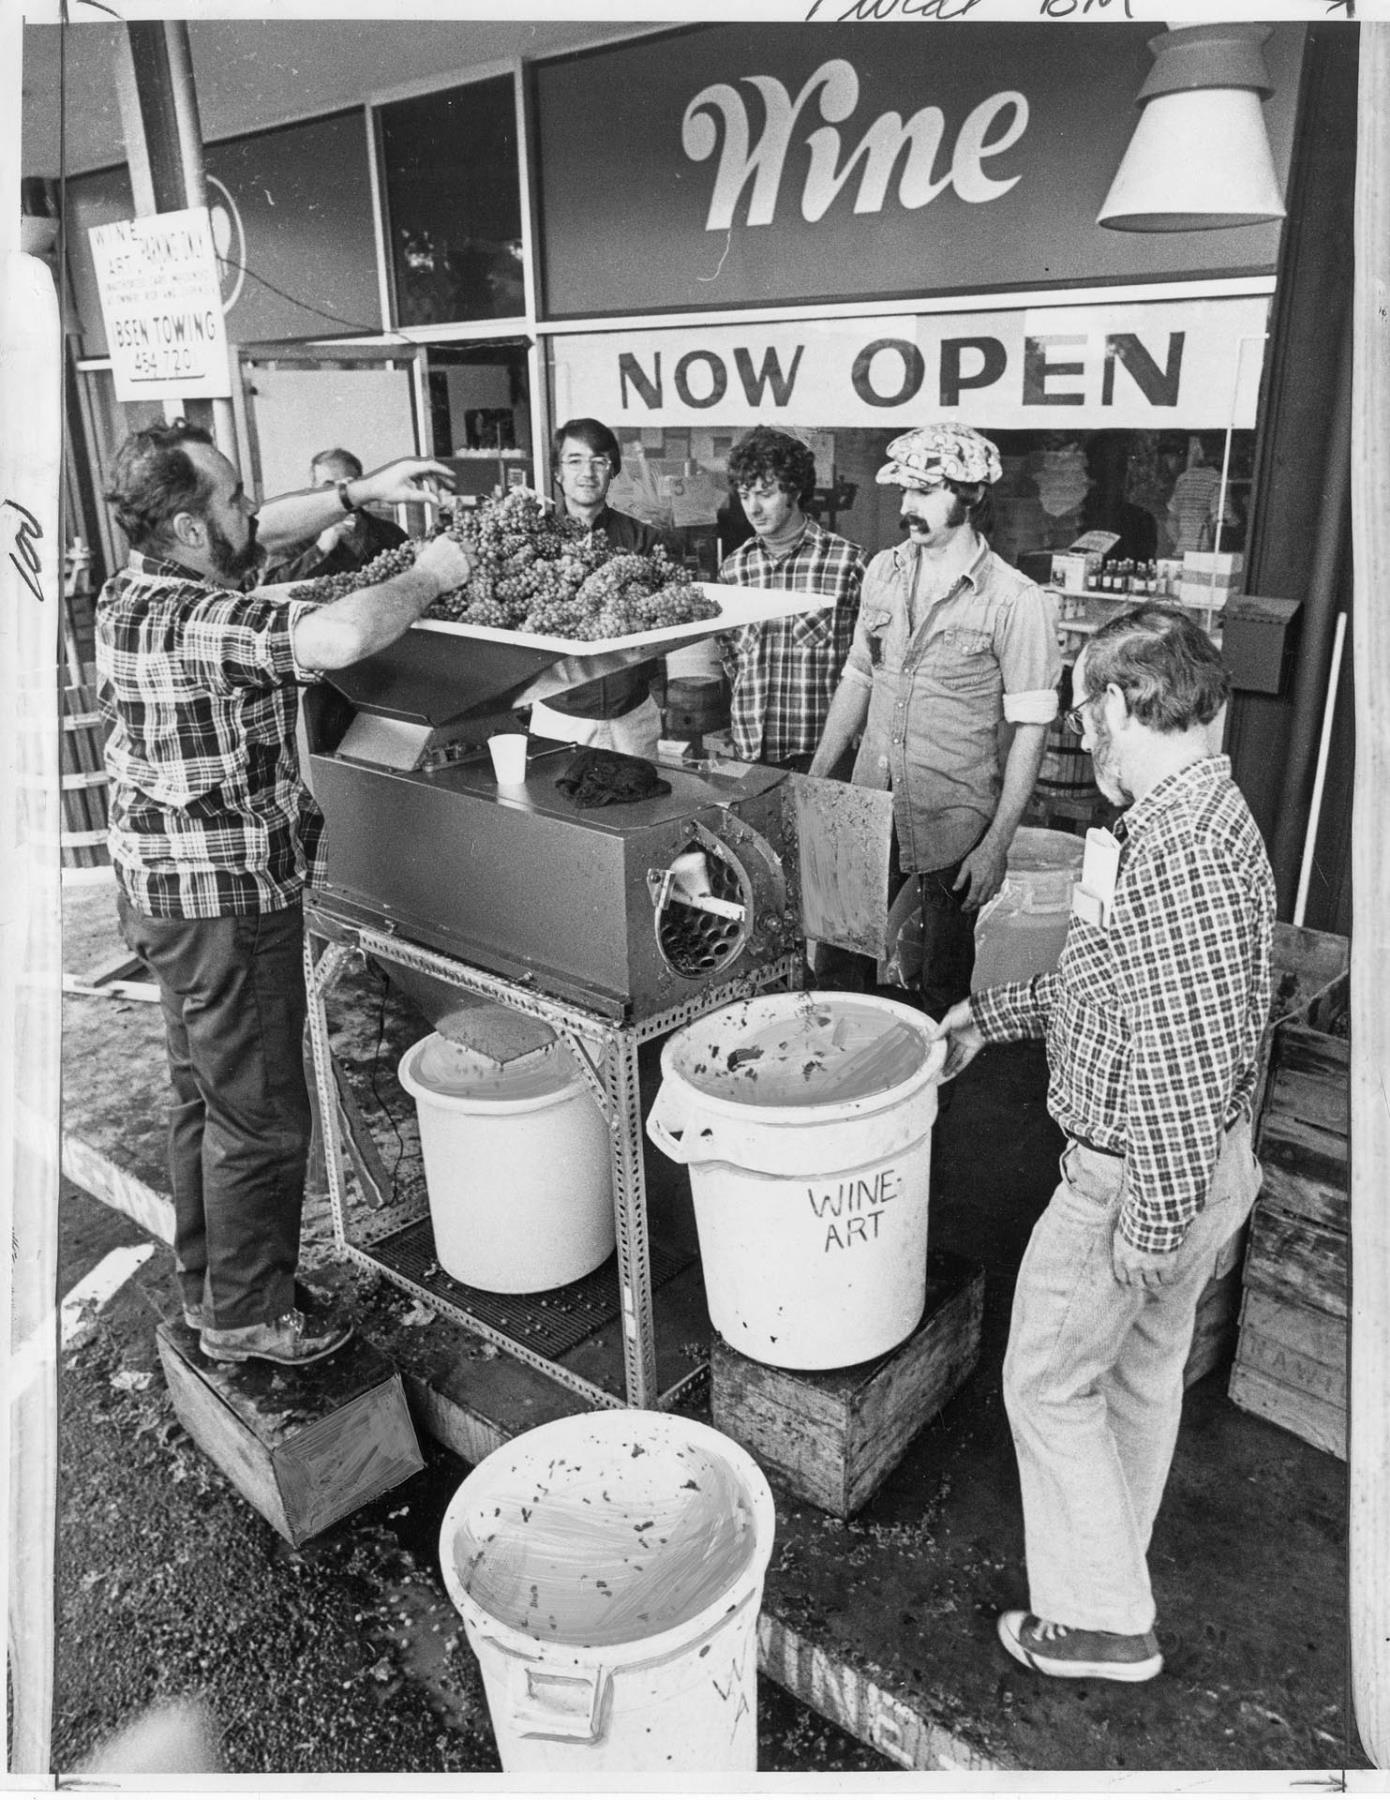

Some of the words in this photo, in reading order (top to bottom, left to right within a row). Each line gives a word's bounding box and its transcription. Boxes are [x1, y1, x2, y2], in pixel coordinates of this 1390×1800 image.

[682, 59, 1029, 231] Wine
[152, 309, 216, 344] TOWING
[617, 344, 805, 410] NOW
[851, 331, 1185, 408] OPEN
[824, 1209, 885, 1253] ART
